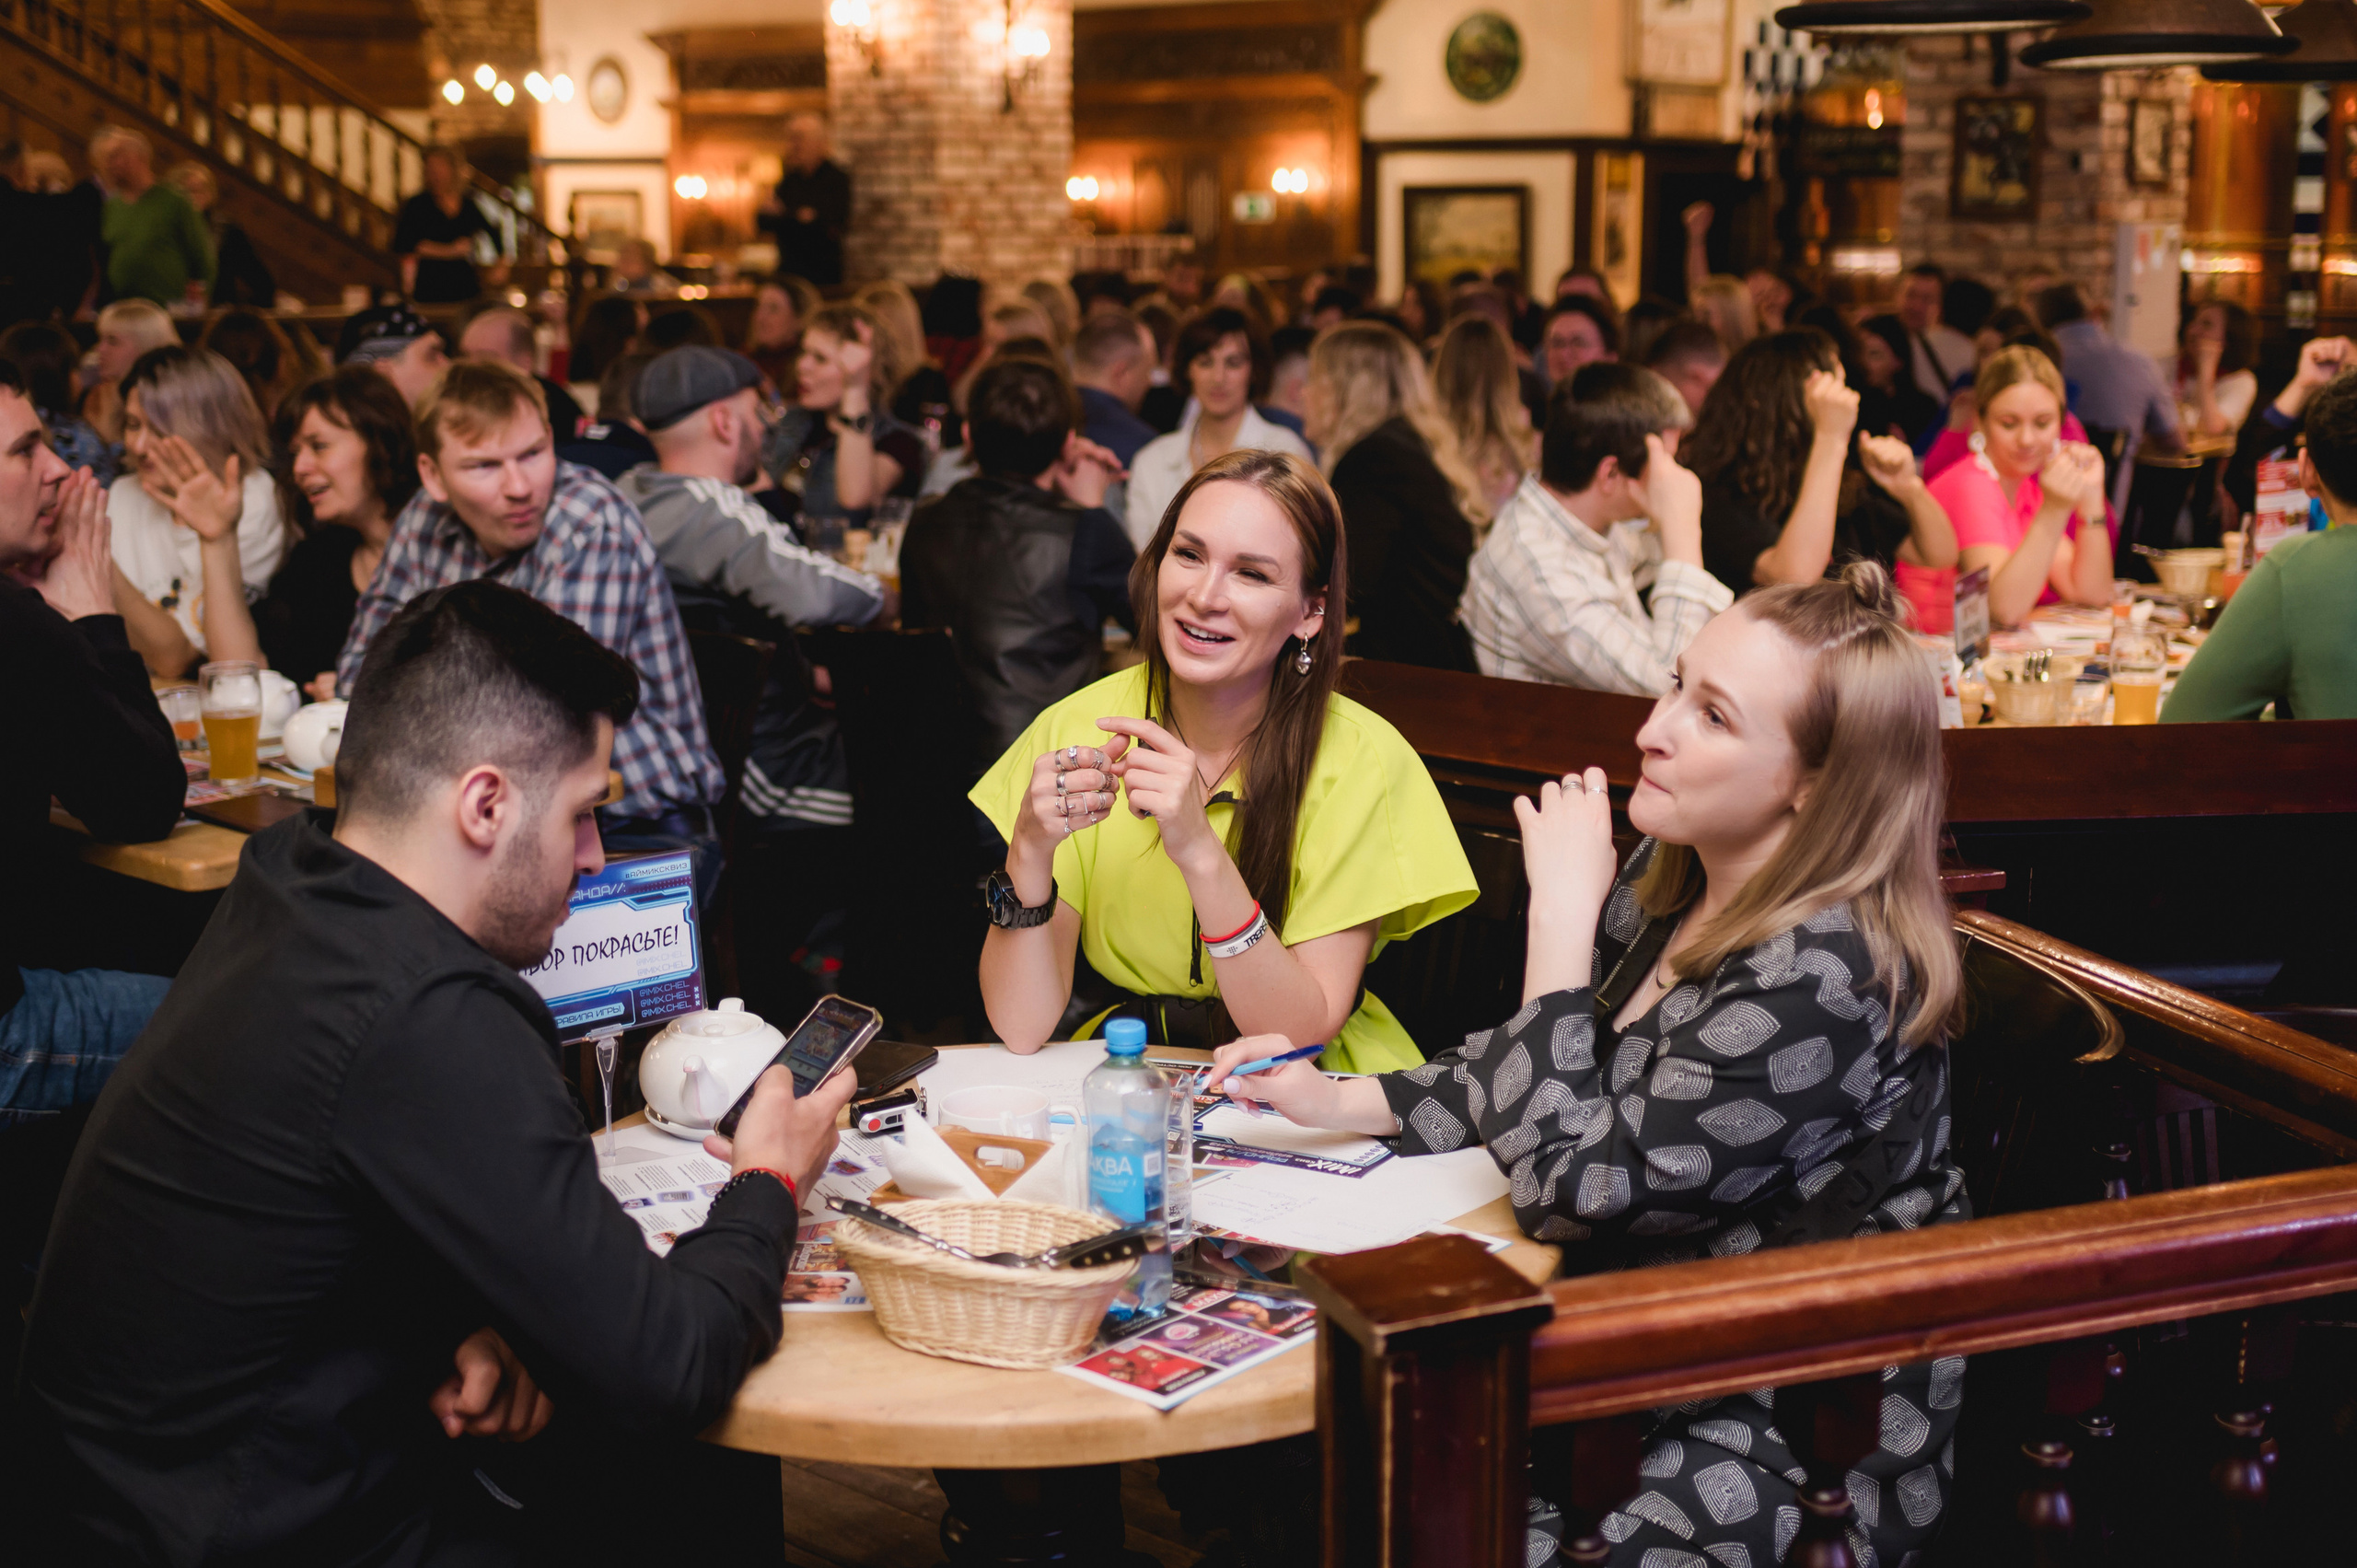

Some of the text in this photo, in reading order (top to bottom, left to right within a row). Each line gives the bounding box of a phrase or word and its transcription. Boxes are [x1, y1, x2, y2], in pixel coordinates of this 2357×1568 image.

[626, 862, 688, 878] #АЙМИКСКВИЗ
[569, 882, 626, 902] АНДА//:
[572, 923, 679, 967] ПОКРАСЬТЕ!
[639, 980, 691, 997] @IMIX.CHEL
[640, 990, 691, 1007] @IMIX.CHEL
[556, 1005, 621, 1026] РАВИЛА ИГРЫ
[641, 1000, 692, 1018] @IMIX.CHEL
